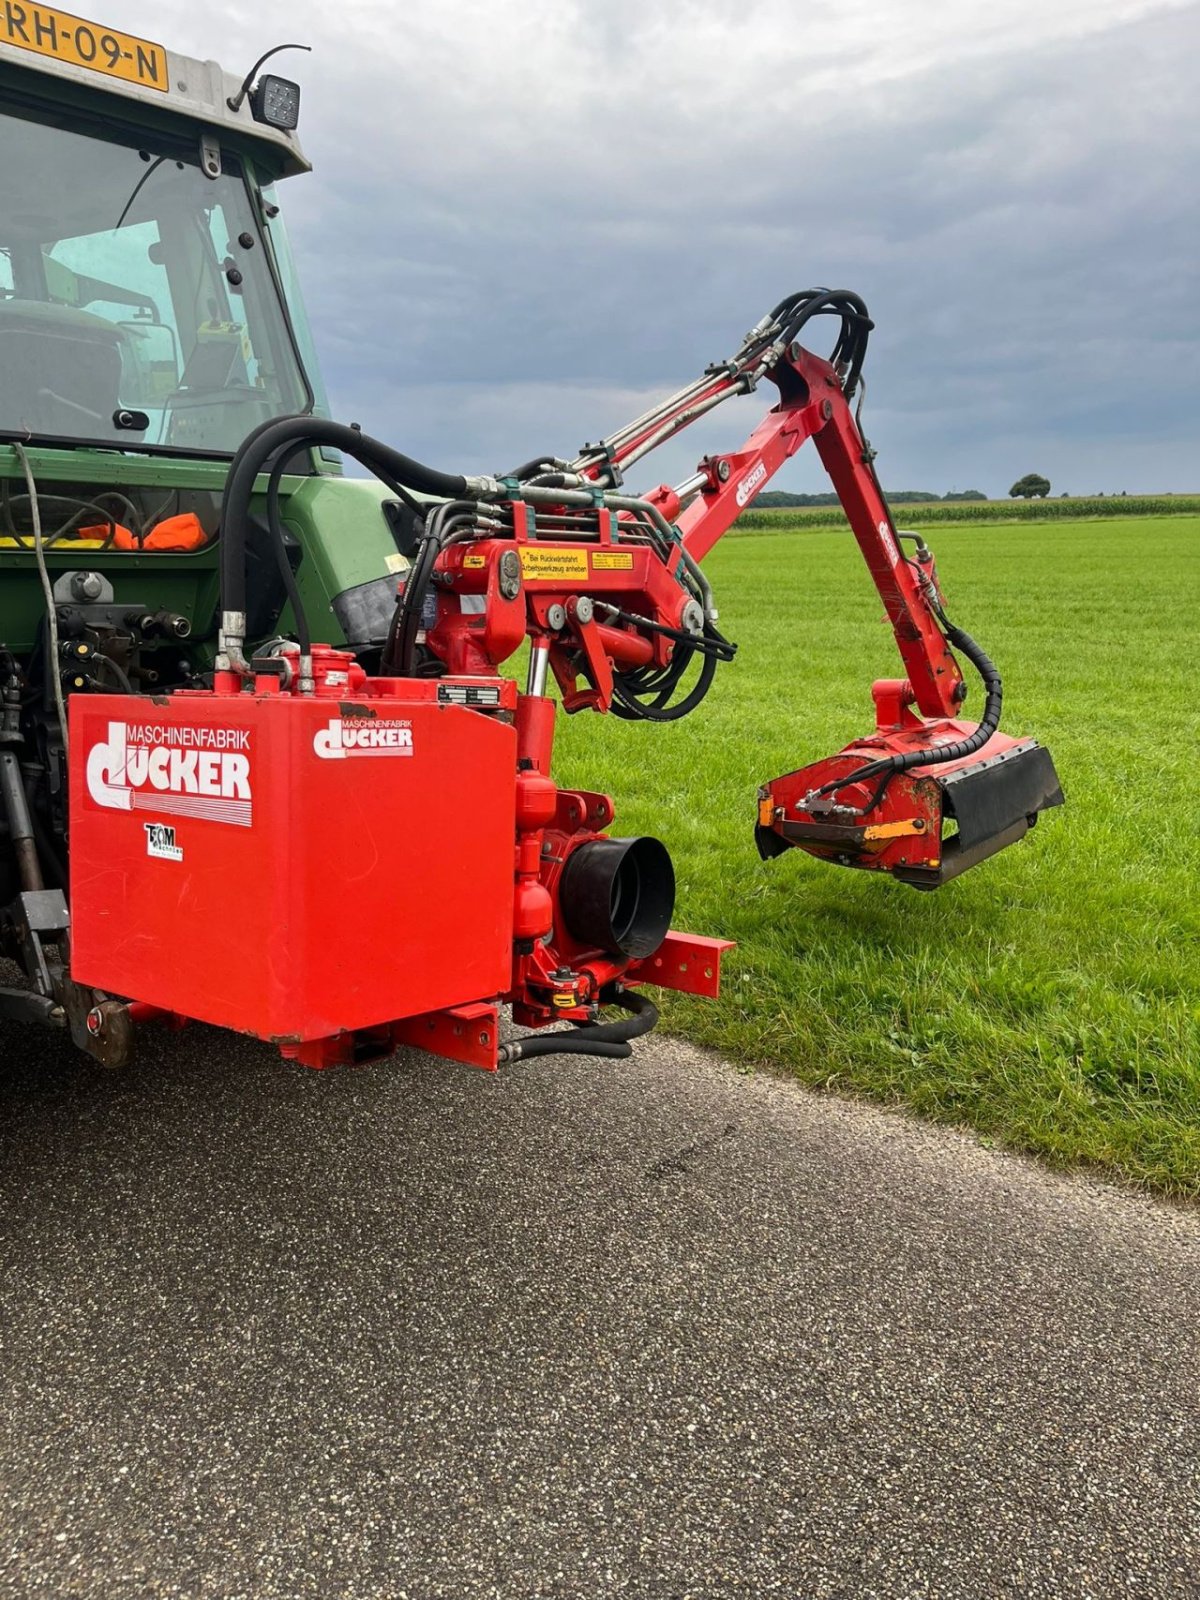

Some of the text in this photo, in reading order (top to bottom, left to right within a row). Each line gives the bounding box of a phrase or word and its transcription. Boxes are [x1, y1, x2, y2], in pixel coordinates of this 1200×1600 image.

[529, 554, 539, 562] Bei
[342, 720, 412, 728] MASCHINENFABRIK
[127, 725, 250, 750] MASCHINENFABRIK
